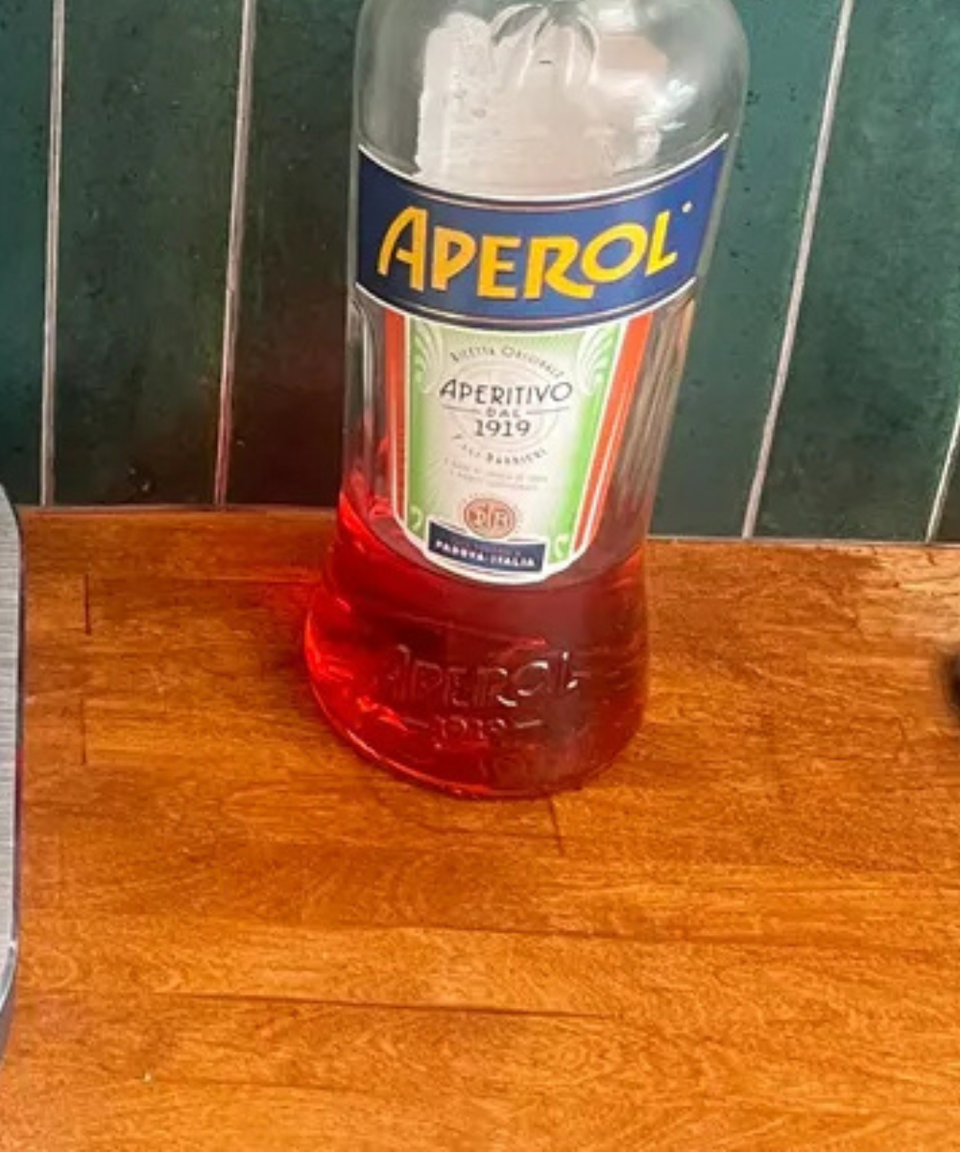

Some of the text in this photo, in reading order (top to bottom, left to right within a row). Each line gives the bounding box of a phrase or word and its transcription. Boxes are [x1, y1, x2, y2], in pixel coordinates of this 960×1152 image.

[377, 205, 678, 300] APEROL
[439, 378, 573, 405] APERITIVO
[486, 407, 521, 418] DAL
[475, 419, 531, 437] 1919
